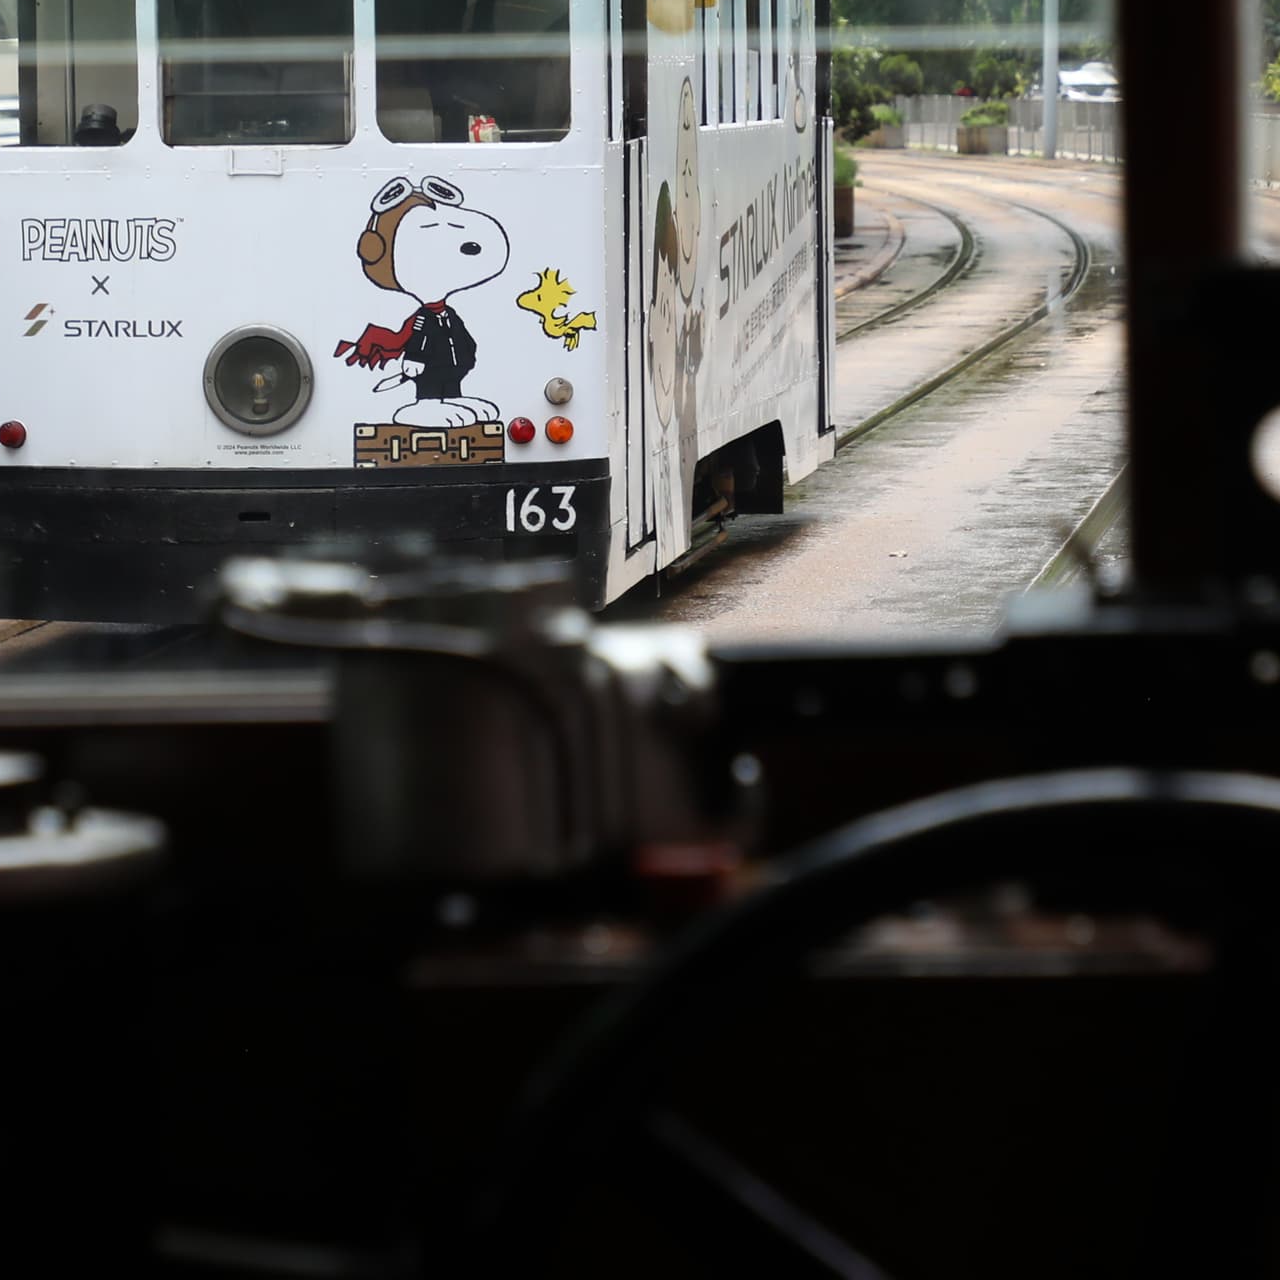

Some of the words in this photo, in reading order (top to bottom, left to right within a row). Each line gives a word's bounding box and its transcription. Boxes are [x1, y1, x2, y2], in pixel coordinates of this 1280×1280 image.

[719, 173, 779, 320] STARLUX
[64, 319, 183, 338] STARLUX
[506, 486, 576, 532] 163
